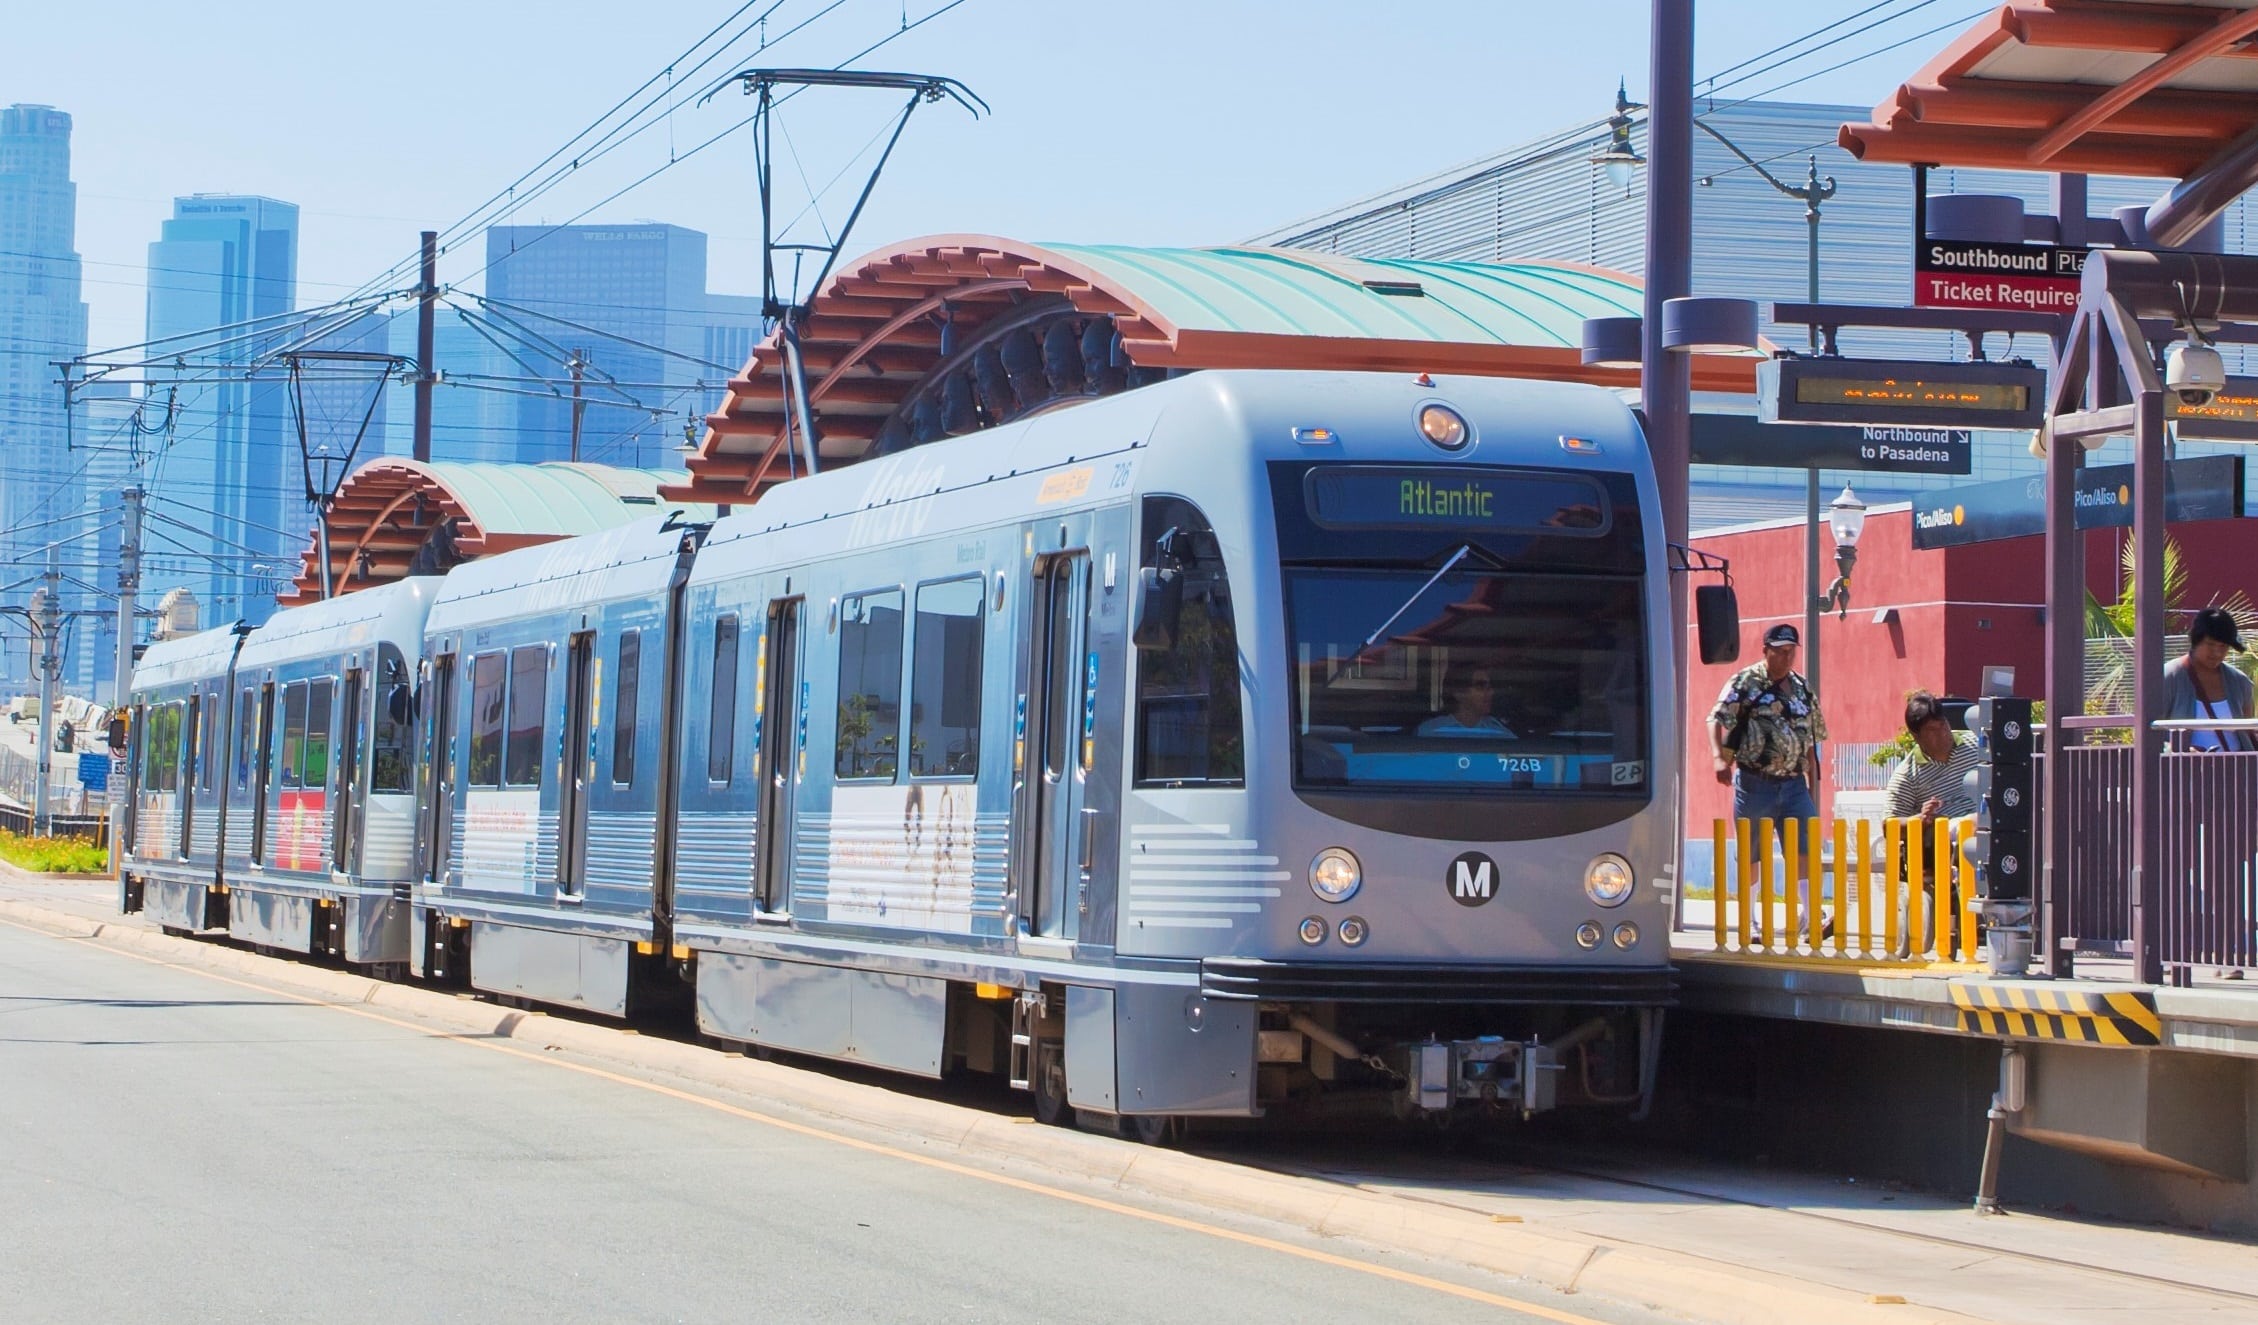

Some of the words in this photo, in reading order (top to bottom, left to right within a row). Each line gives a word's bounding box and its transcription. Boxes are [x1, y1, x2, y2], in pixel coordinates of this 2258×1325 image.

[1931, 247, 2048, 271] Southbound
[2059, 254, 2084, 271] Pla
[1931, 281, 1993, 302] Ticket
[1863, 427, 1949, 444] Northbound
[1861, 446, 1876, 459] to
[1879, 447, 1949, 462] Pasadena
[1401, 480, 1493, 516] Atlantic
[2075, 487, 2117, 507] Pico/Aliso
[1916, 508, 1953, 529] Pico/Aliso
[1498, 758, 1541, 771] 726B
[1455, 860, 1491, 898] M
